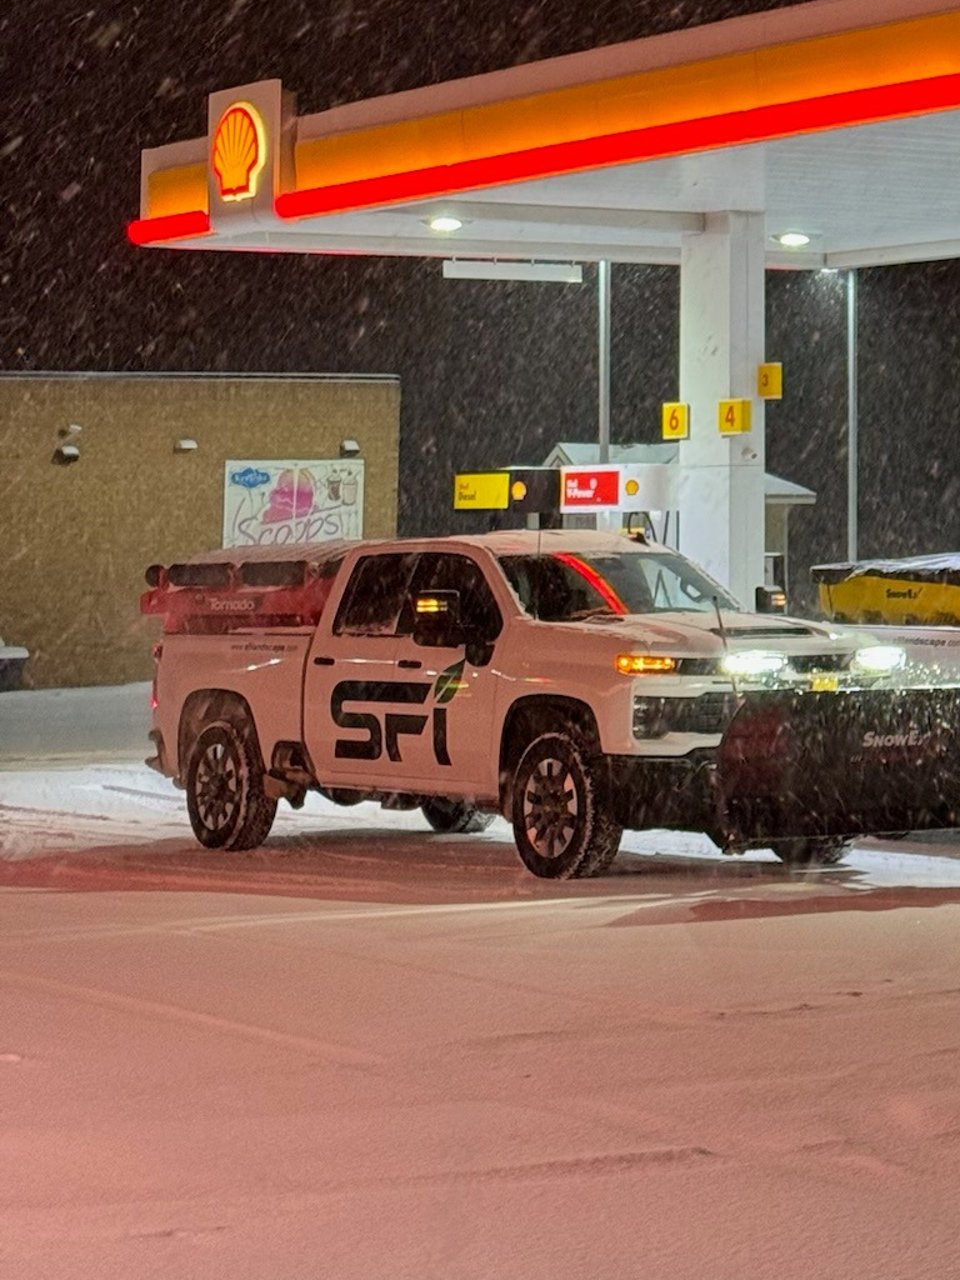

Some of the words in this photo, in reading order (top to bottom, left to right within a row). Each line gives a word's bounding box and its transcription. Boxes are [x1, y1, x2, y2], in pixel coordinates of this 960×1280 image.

[761, 373, 769, 388] 3
[669, 408, 679, 431] 6
[725, 405, 736, 427] 4
[210, 598, 255, 611] Tornado
